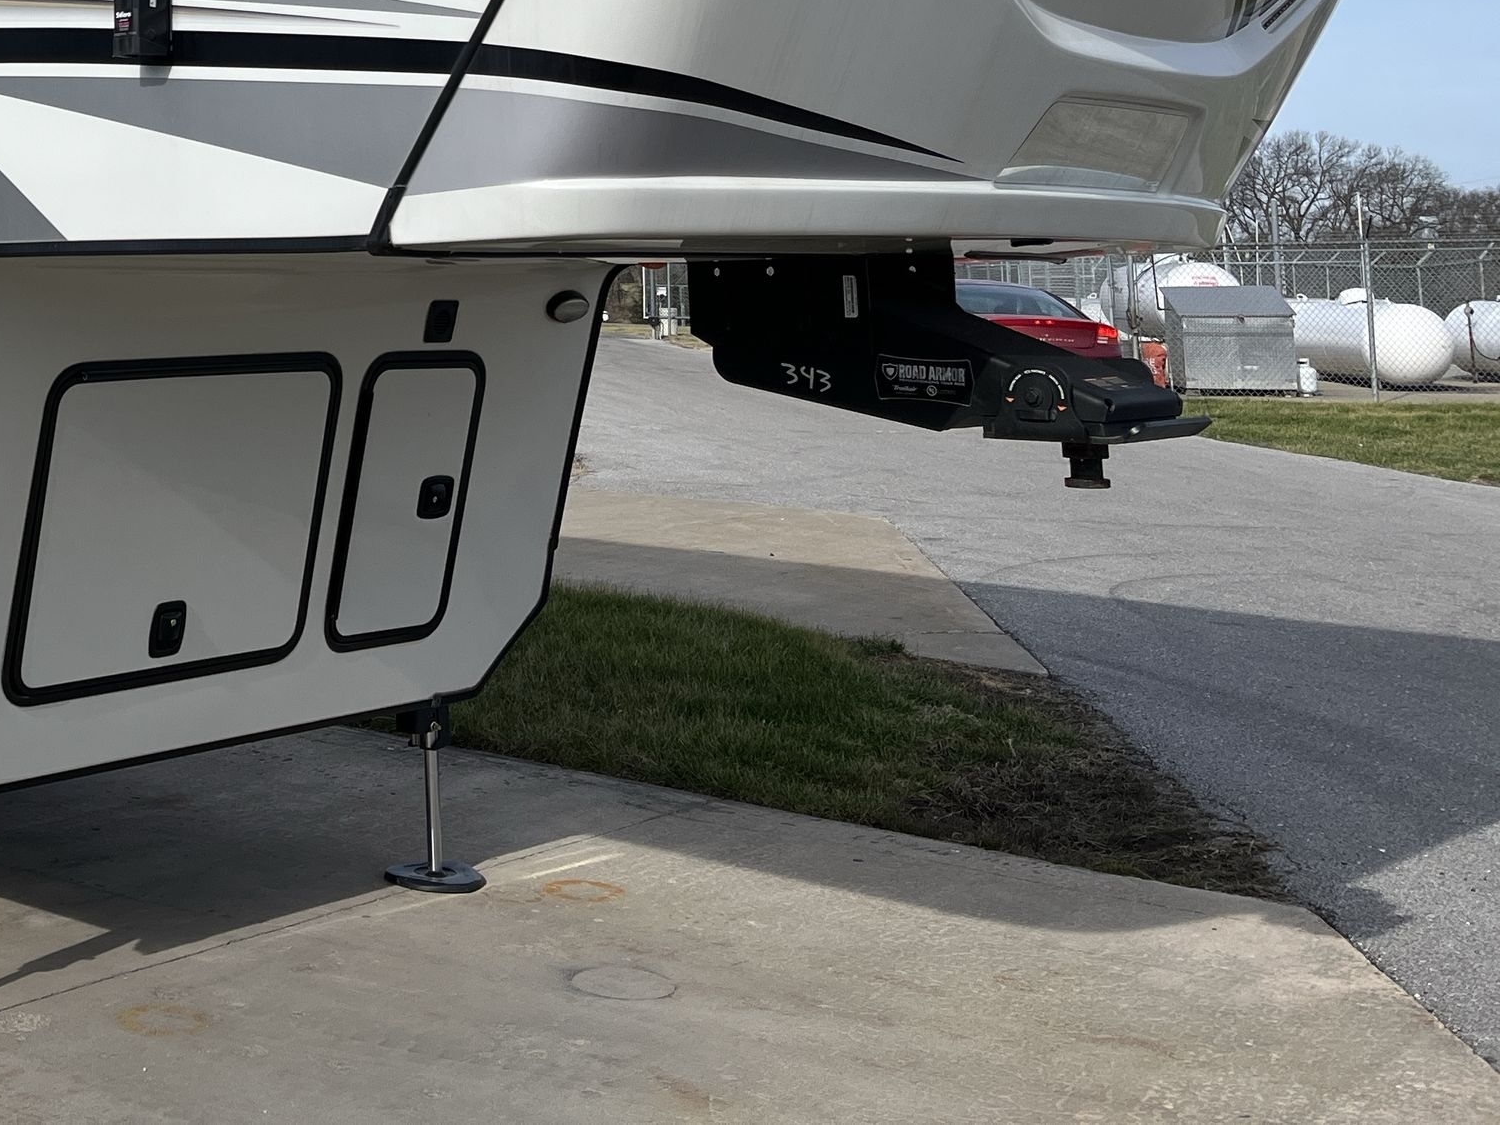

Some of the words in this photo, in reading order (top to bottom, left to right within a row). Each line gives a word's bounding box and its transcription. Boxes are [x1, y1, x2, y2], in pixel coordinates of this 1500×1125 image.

[780, 362, 832, 393] 343
[898, 363, 926, 379] ROAD
[928, 365, 965, 382] ARMOR
